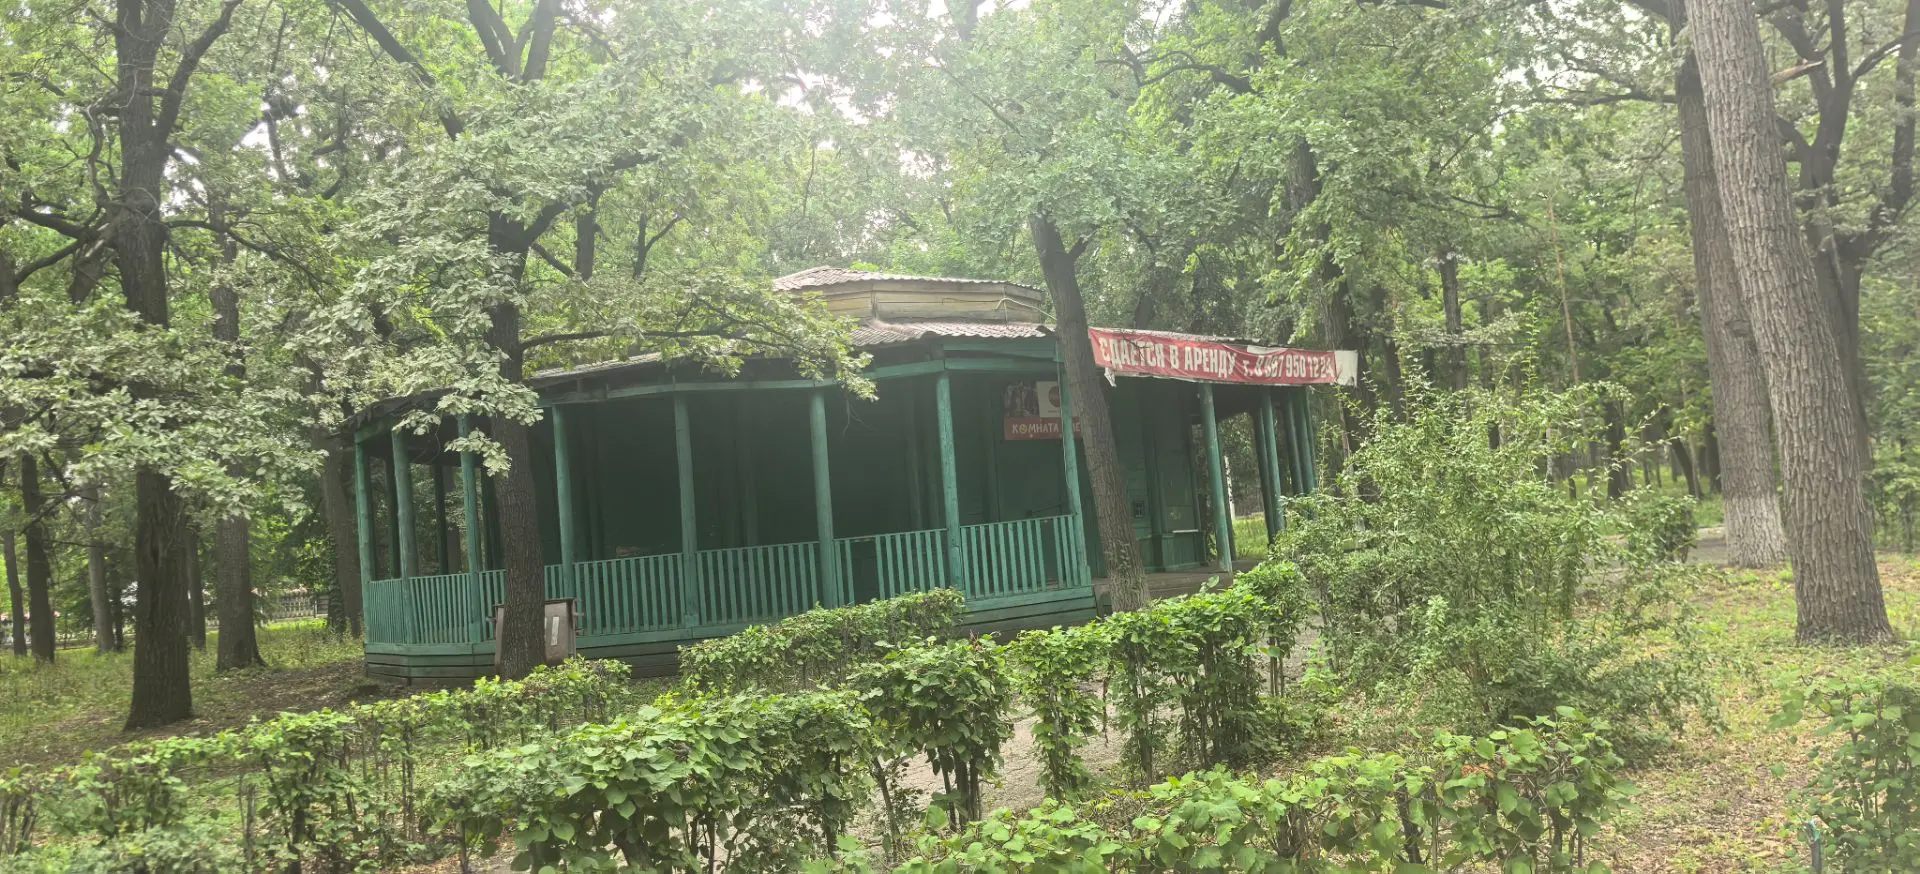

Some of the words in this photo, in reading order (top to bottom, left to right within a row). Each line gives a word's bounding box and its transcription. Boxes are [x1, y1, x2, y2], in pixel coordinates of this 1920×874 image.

[1098, 336, 1165, 369] СДАЕТСЯ
[1169, 344, 1180, 370] В
[1184, 346, 1236, 378] АРЕНДУ
